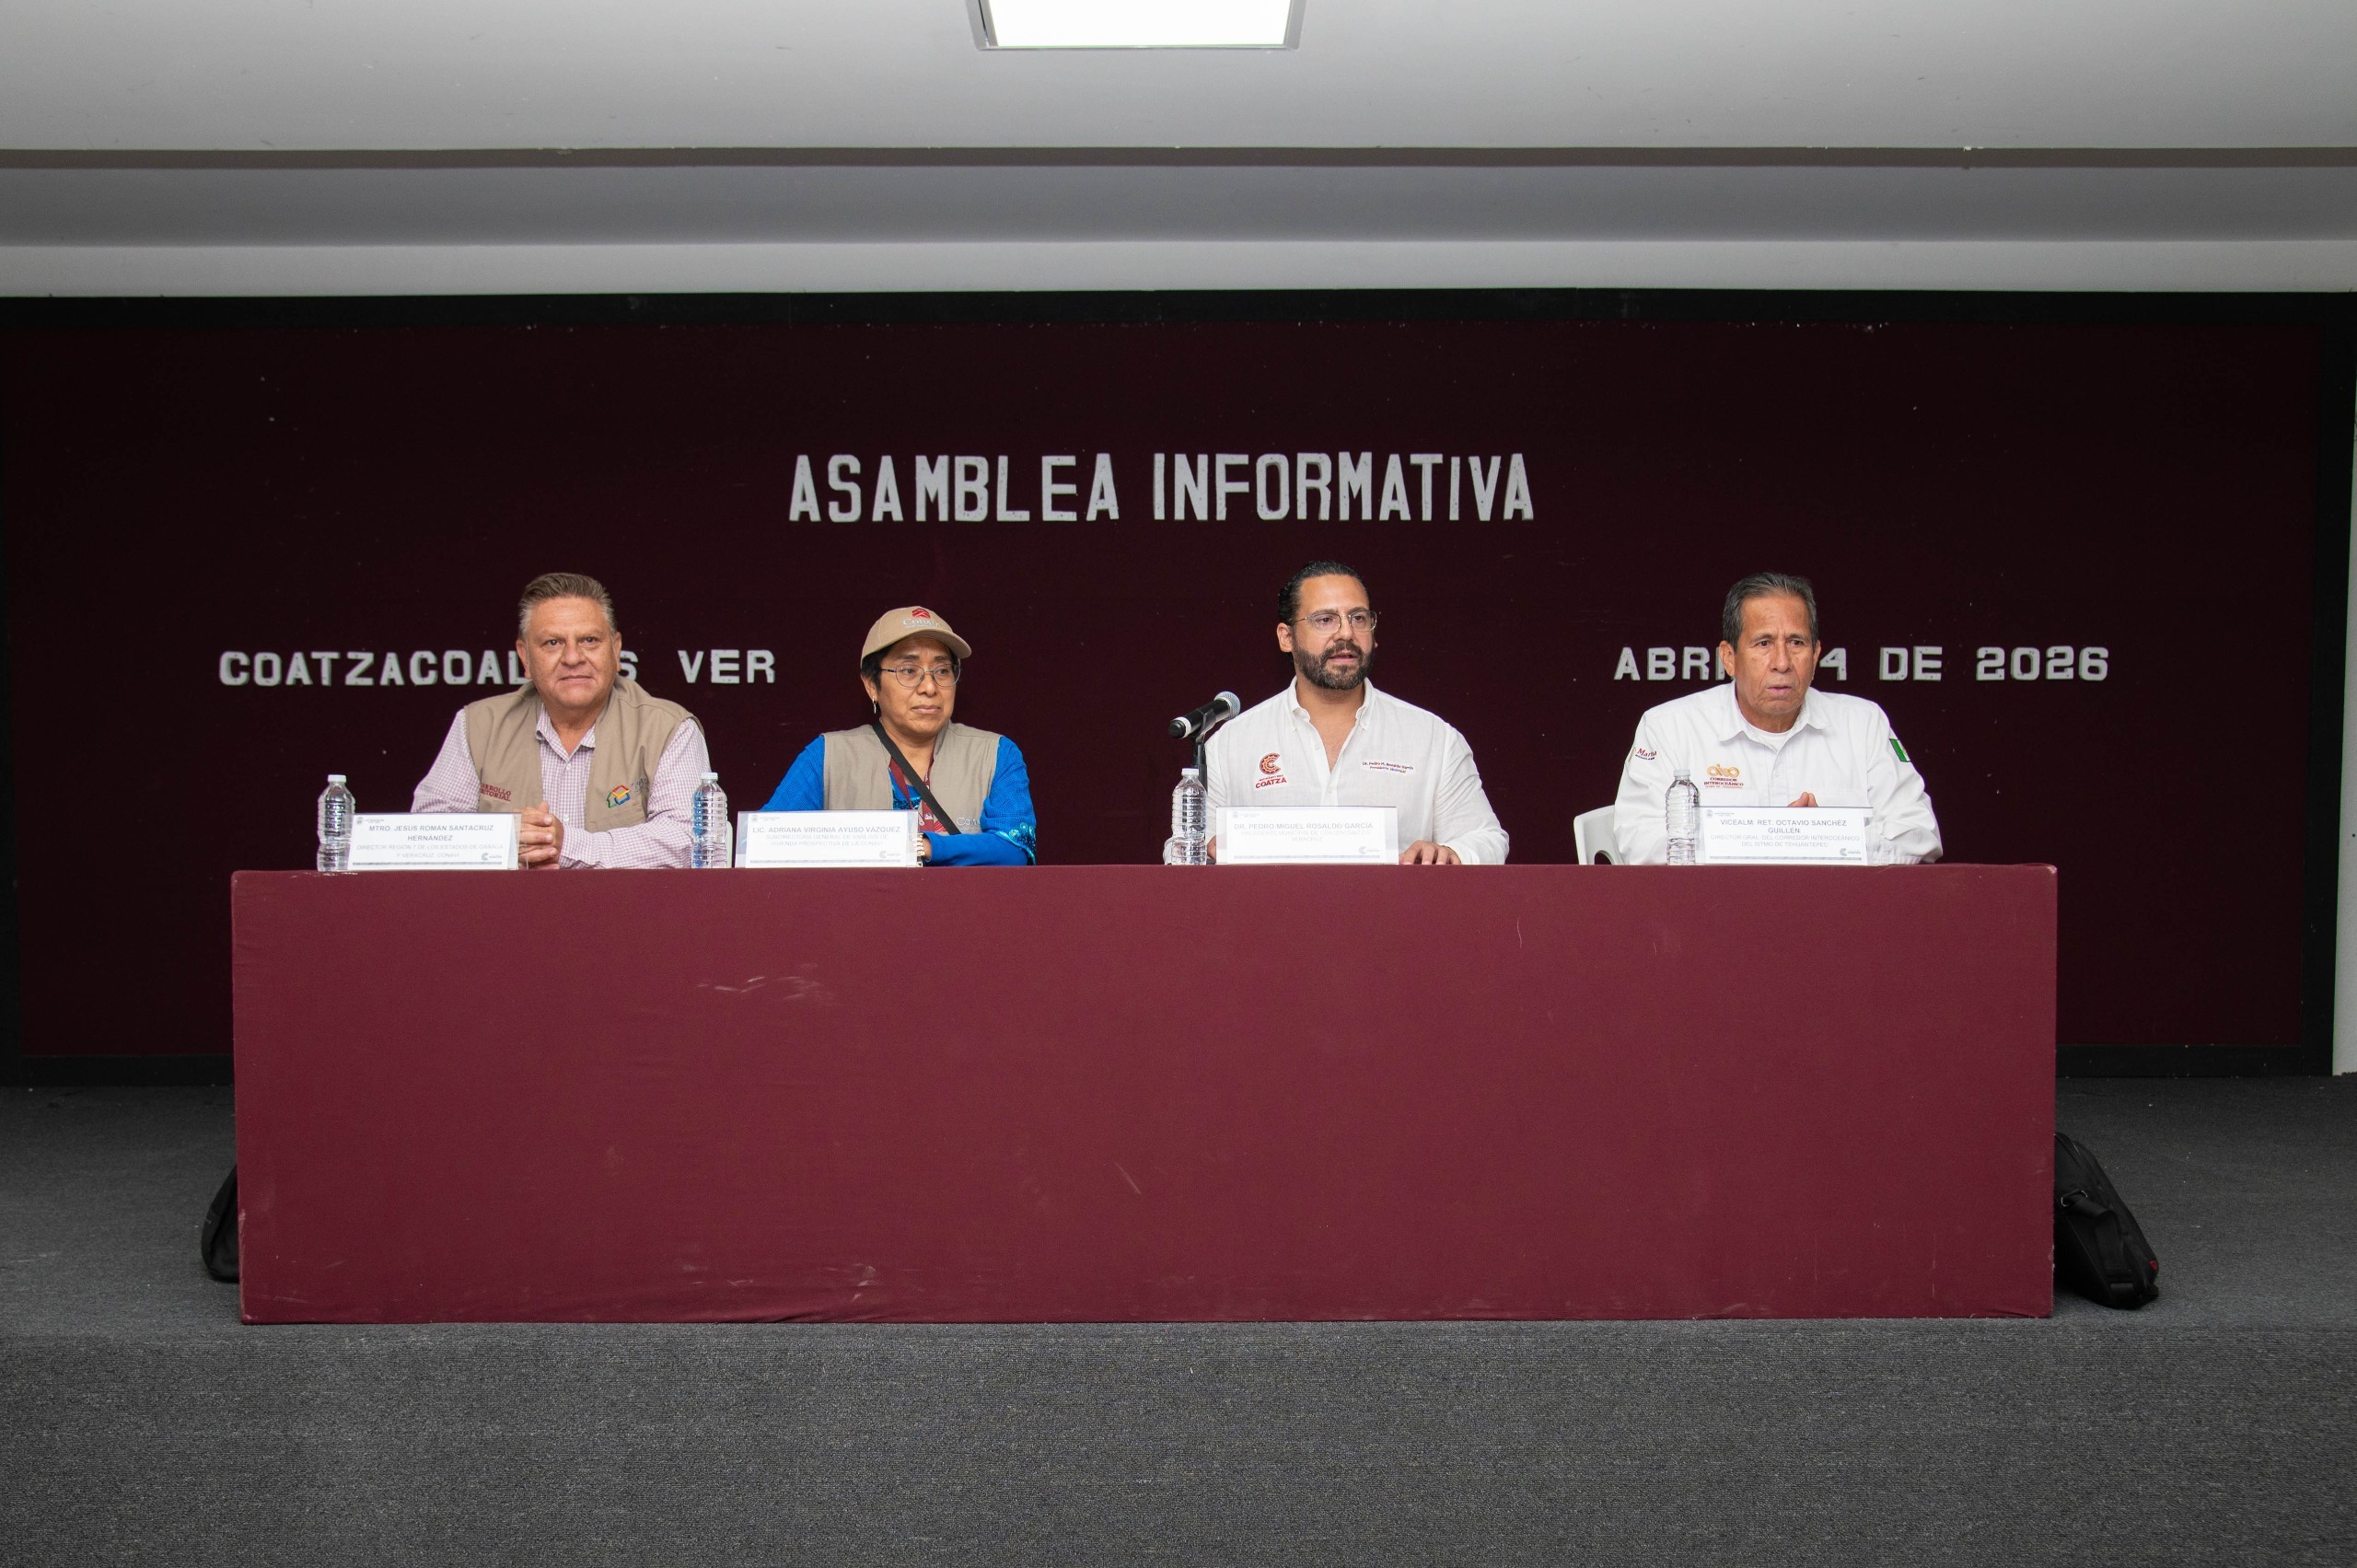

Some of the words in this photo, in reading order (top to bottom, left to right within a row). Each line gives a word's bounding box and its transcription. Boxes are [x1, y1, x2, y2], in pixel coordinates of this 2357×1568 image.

[790, 454, 1119, 522] ASAMBLEA
[1154, 452, 1533, 521] INFORMATIVA
[219, 649, 638, 686] COATZACOALS
[678, 650, 774, 683] VER
[1613, 646, 1726, 681] ABRI
[1880, 646, 1942, 680] DE
[1977, 646, 2108, 680] 2026
[1255, 777, 1287, 789] COATZA
